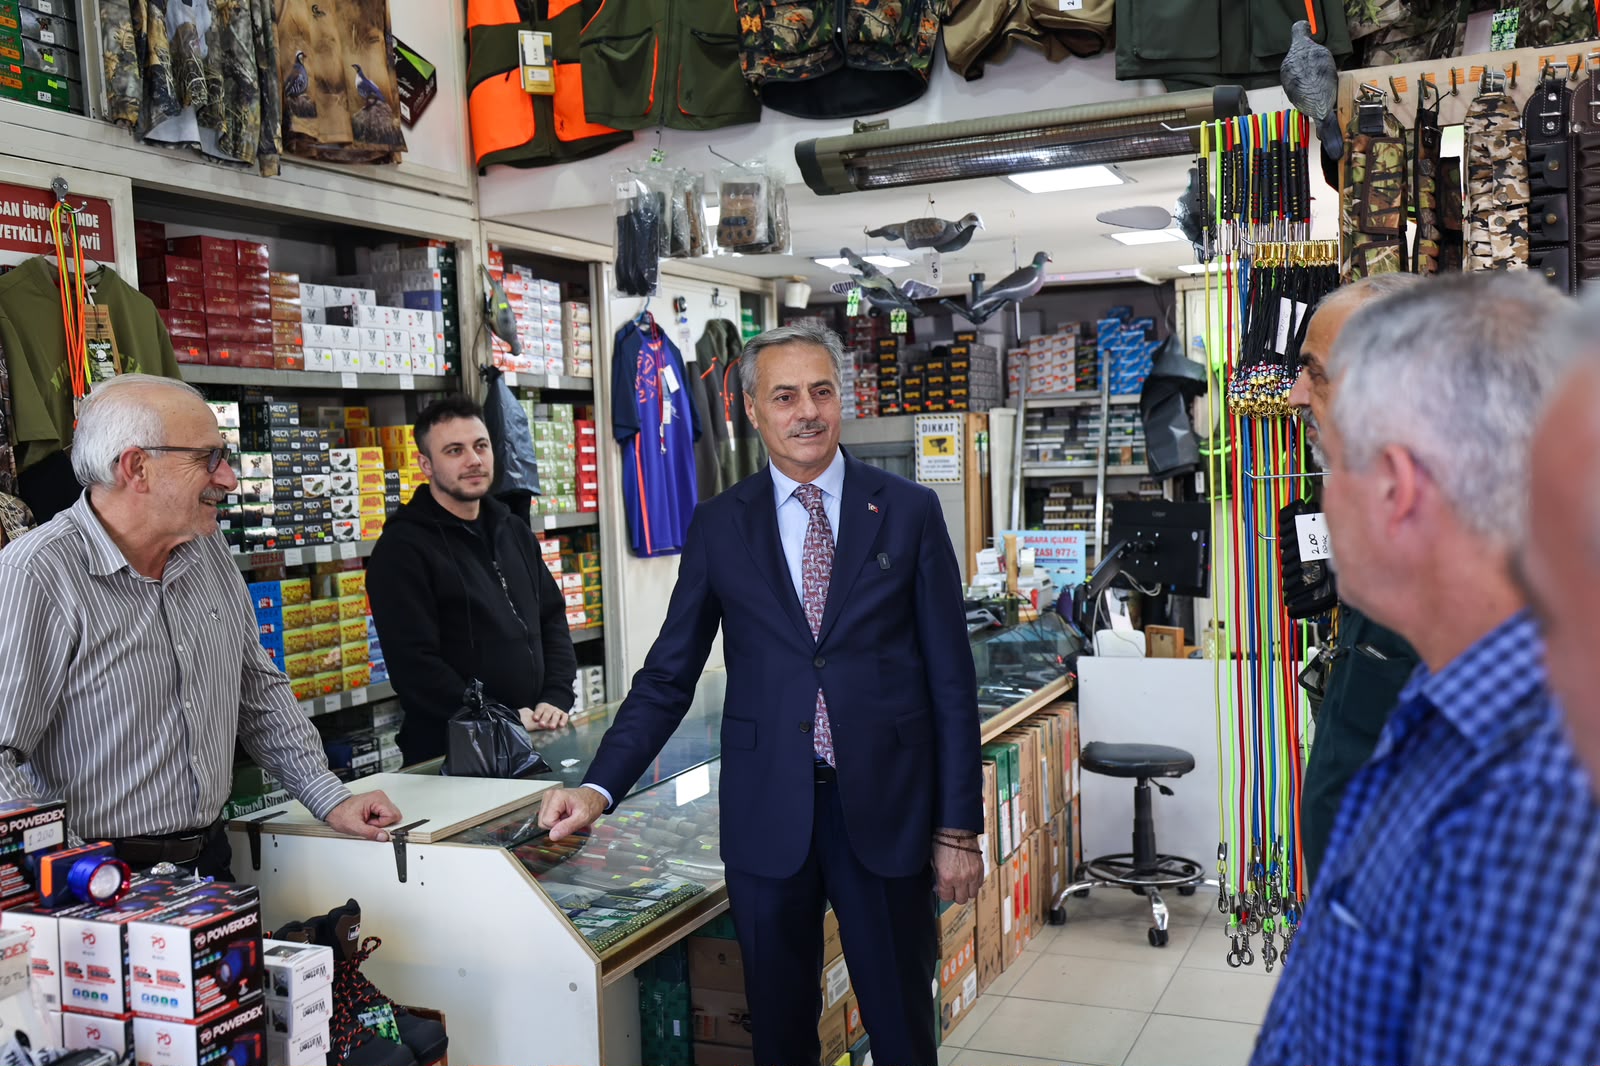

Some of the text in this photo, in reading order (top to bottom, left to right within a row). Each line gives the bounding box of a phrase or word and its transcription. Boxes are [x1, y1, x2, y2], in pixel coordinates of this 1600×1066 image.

[23, 200, 99, 228] ÜRÜNEİNDE
[45, 230, 71, 246] AA
[79, 233, 101, 251] AYİİ
[1035, 548, 1053, 557] ZASI
[9, 808, 65, 832] POWERDEX
[206, 912, 258, 944] POWERDEX
[212, 1004, 264, 1038] POWERDEX
